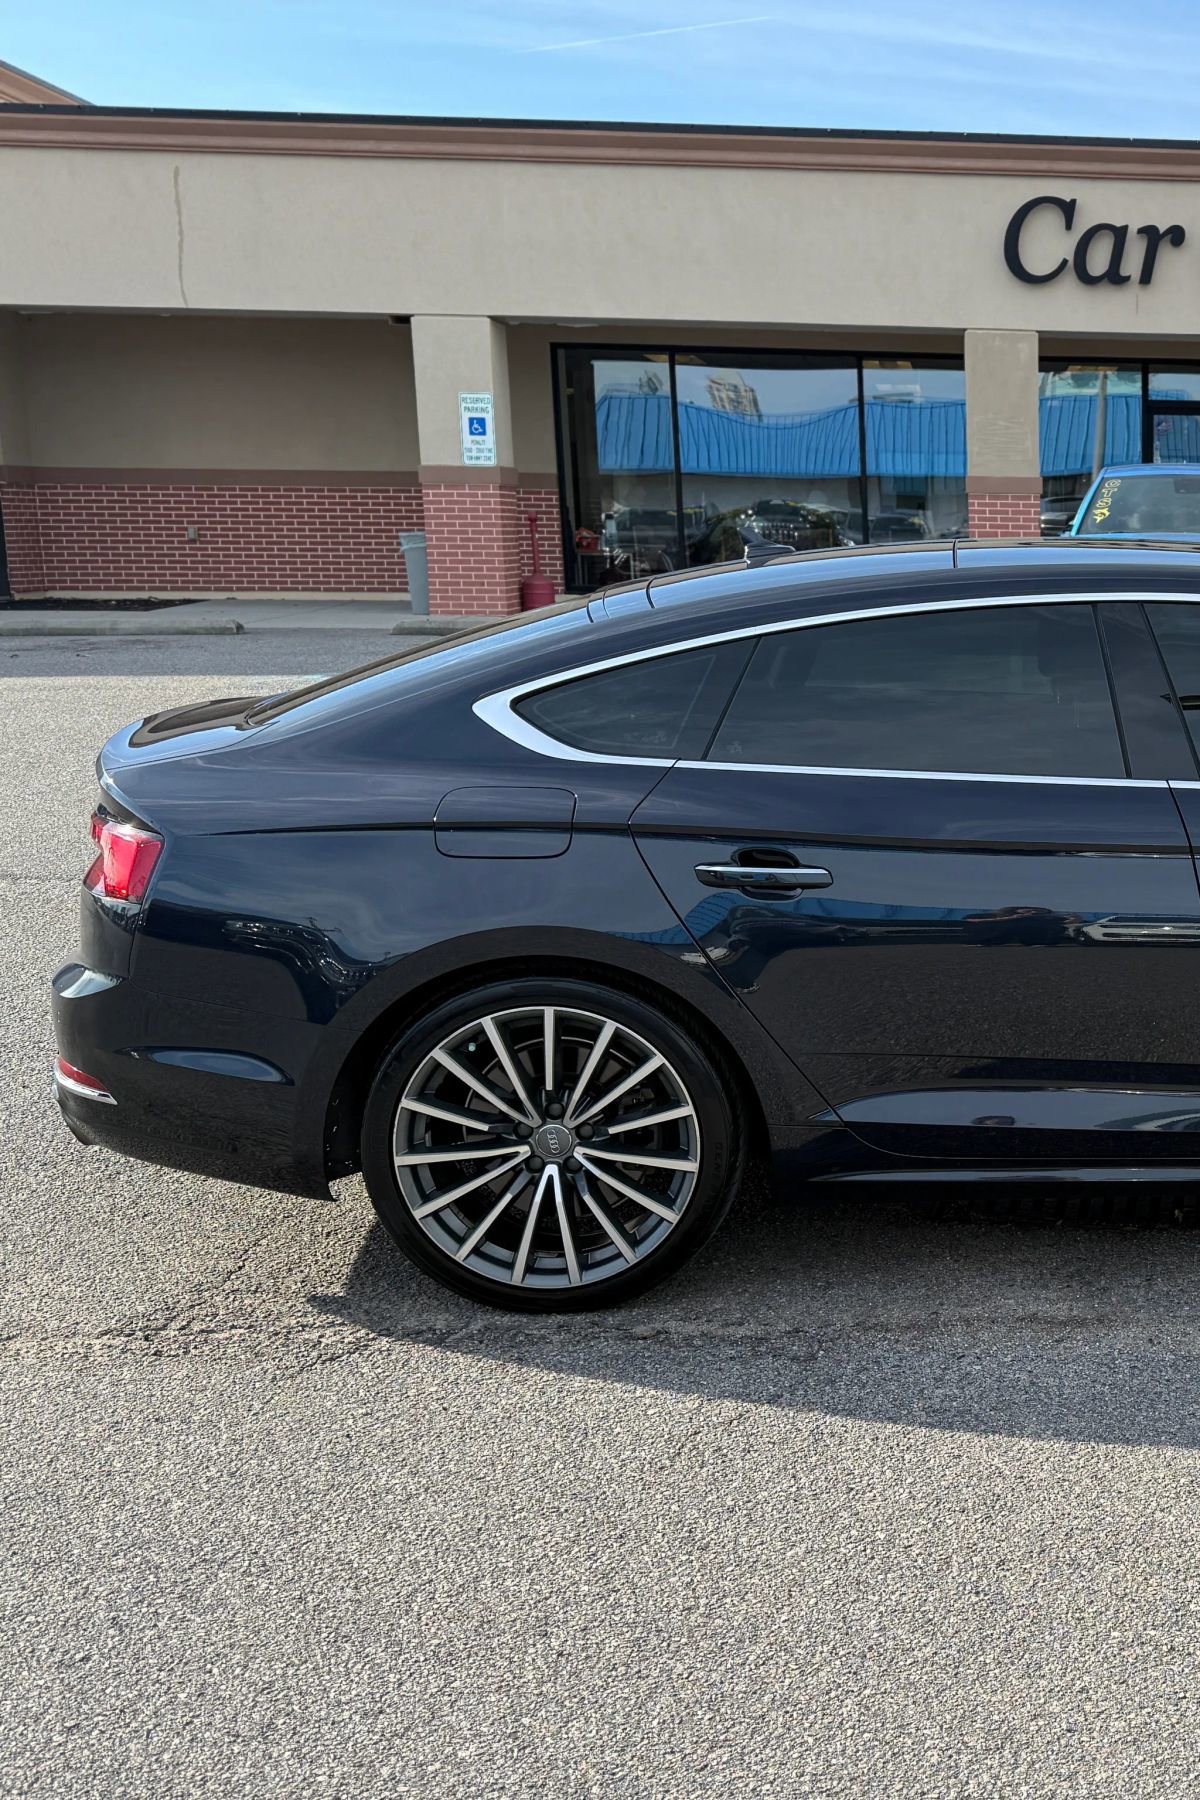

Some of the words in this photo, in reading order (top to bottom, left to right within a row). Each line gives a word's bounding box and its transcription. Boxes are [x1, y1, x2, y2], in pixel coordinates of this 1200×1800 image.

[1004, 196, 1186, 285] Car
[461, 396, 491, 405] RESERVED
[463, 406, 490, 414] PARKING
